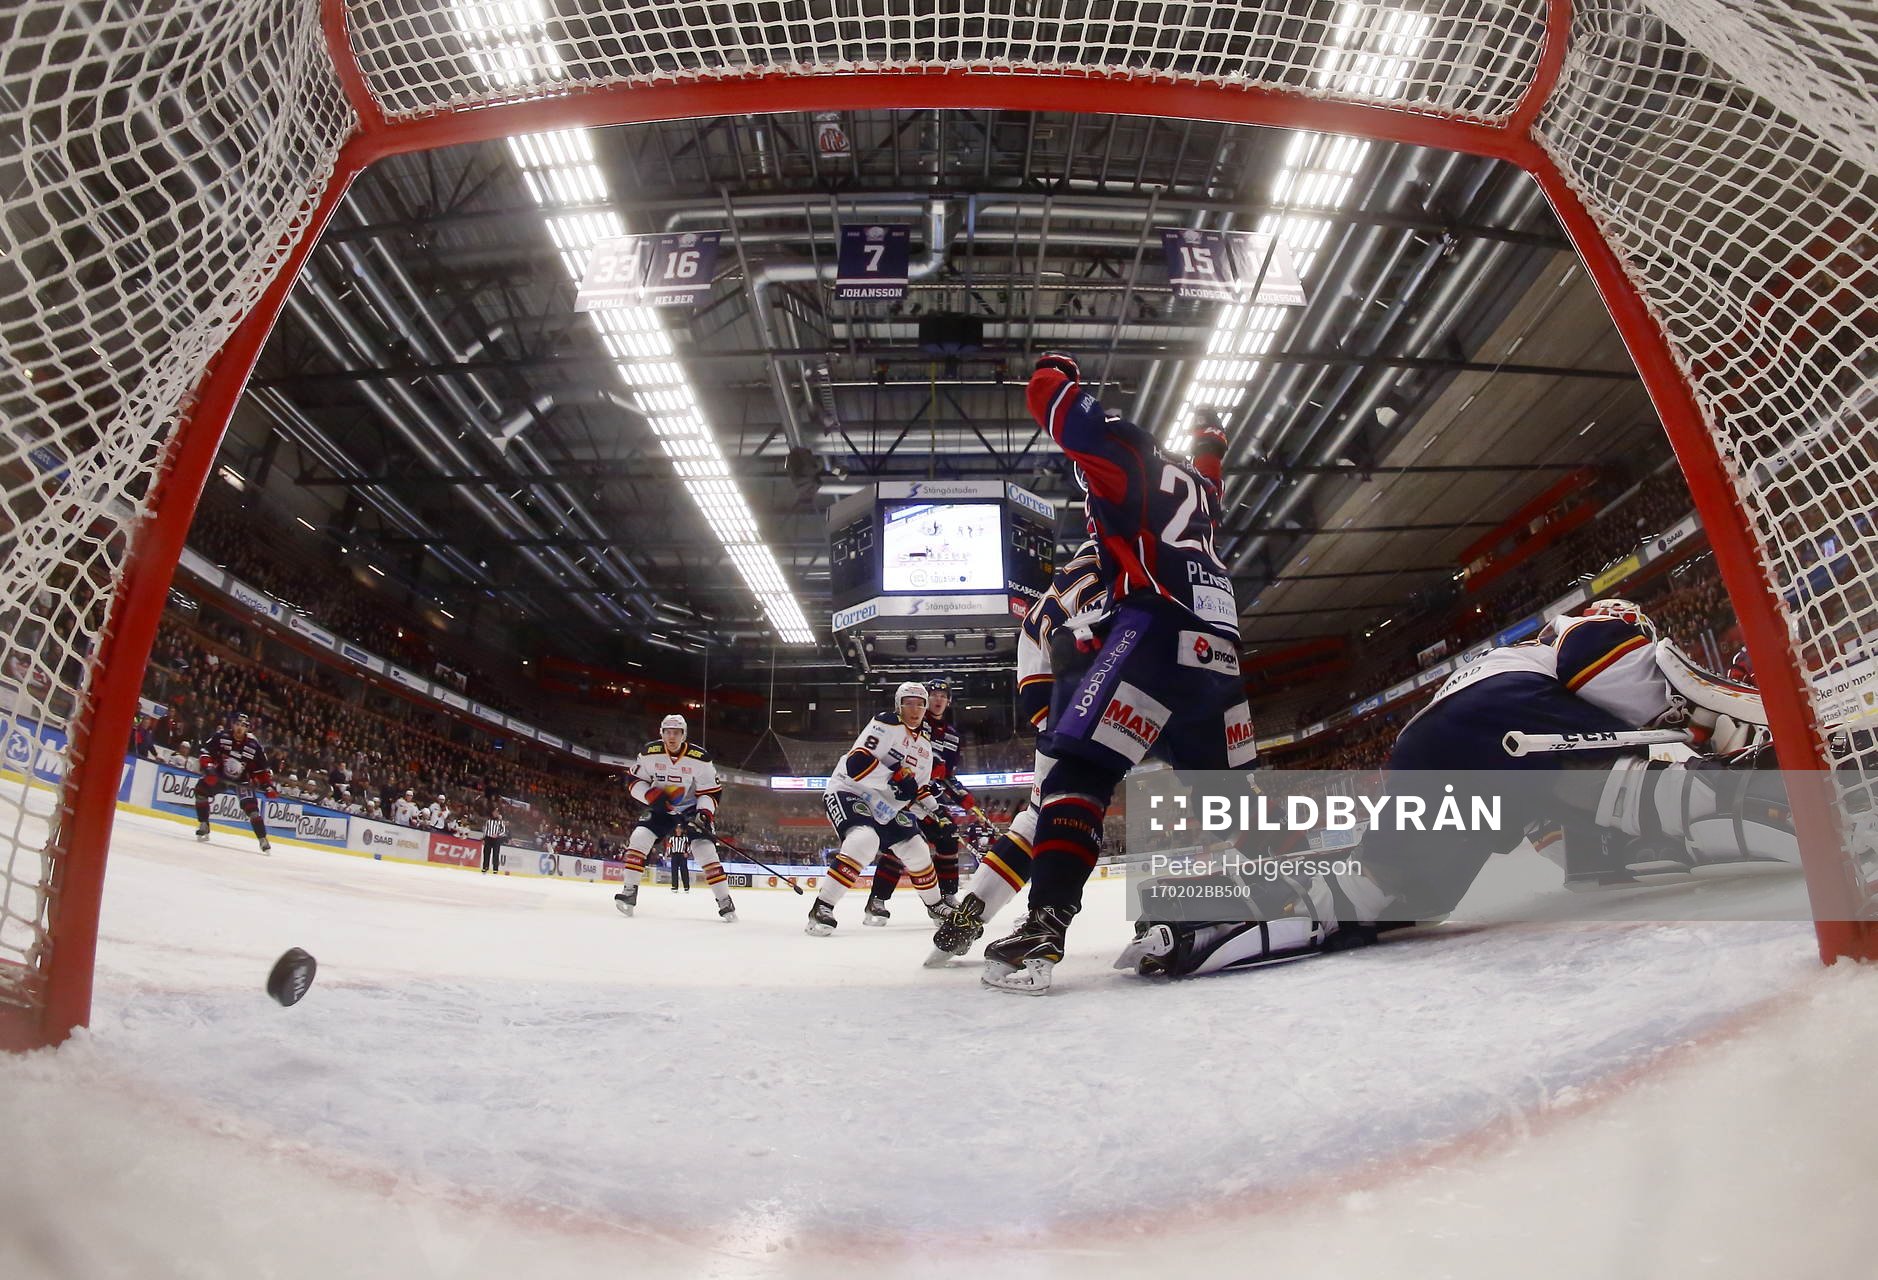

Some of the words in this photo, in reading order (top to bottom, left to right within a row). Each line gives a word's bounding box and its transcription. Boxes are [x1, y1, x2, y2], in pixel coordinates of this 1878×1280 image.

[663, 250, 700, 279] 16
[863, 244, 885, 272] 7
[1179, 246, 1215, 274] 15
[655, 294, 694, 305] HELBER
[839, 288, 903, 298] JOHANSSON
[923, 484, 979, 497] Stångåstaden
[1008, 484, 1054, 520] Corren
[834, 602, 877, 629] Corren
[925, 600, 982, 613] Stångåstaden
[1104, 698, 1160, 745] MAXI
[864, 734, 879, 751] 8
[1560, 732, 1618, 743] CCM
[162, 771, 197, 798] Deko
[297, 815, 338, 841] Reklam
[373, 833, 394, 846] SAAB
[433, 841, 478, 861] CCM
[582, 863, 597, 874] SAAB
